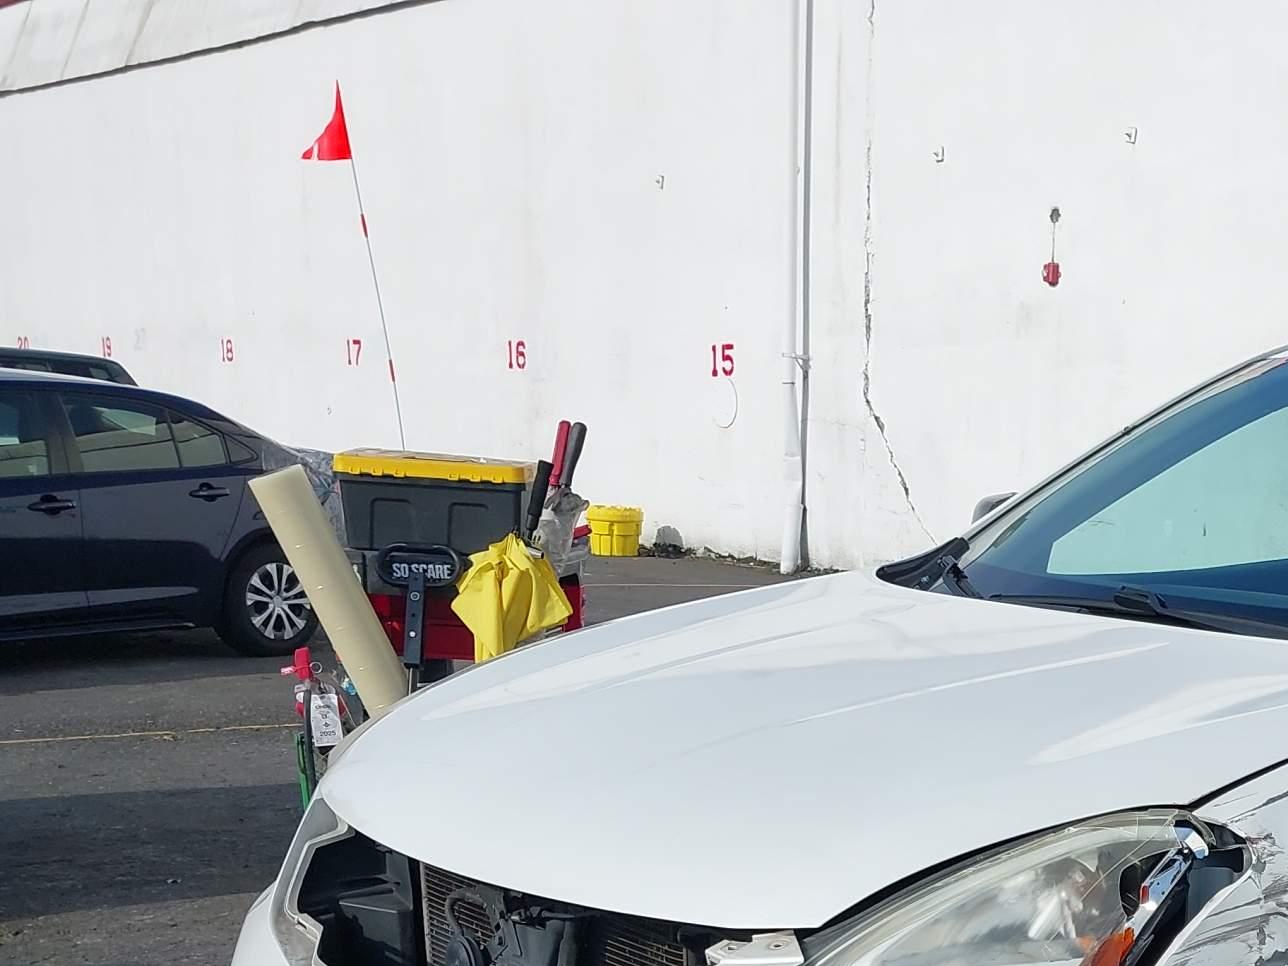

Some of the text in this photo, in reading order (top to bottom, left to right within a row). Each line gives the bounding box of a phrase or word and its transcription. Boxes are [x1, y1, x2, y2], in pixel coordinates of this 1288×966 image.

[101, 335, 113, 357] 19
[220, 339, 234, 362] 18
[346, 339, 363, 366] 17
[507, 339, 527, 370] 16
[711, 343, 735, 378] 15
